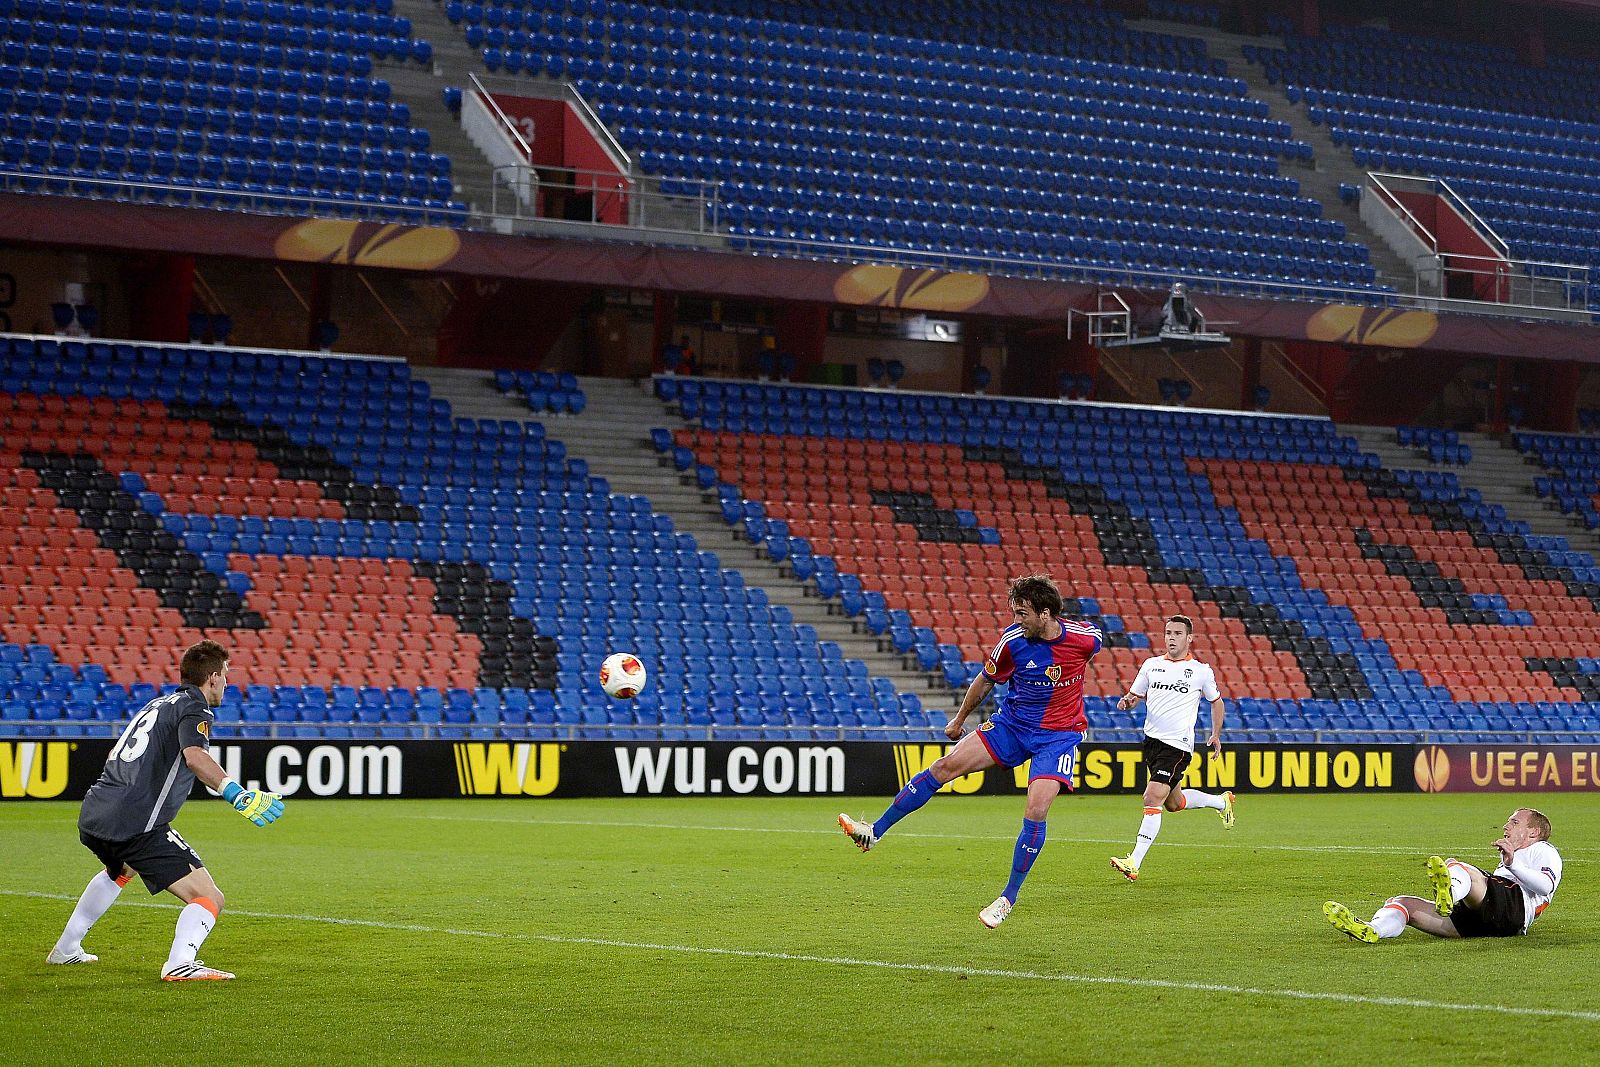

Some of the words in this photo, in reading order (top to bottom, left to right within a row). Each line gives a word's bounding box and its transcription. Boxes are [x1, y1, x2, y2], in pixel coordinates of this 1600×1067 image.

[110, 708, 159, 763] 13
[206, 745, 402, 796] u.com
[464, 743, 561, 796] WU
[614, 746, 846, 794] wu.com
[1057, 754, 1071, 775] 10
[1249, 750, 1393, 788] UNION
[1470, 751, 1561, 787] UEFA
